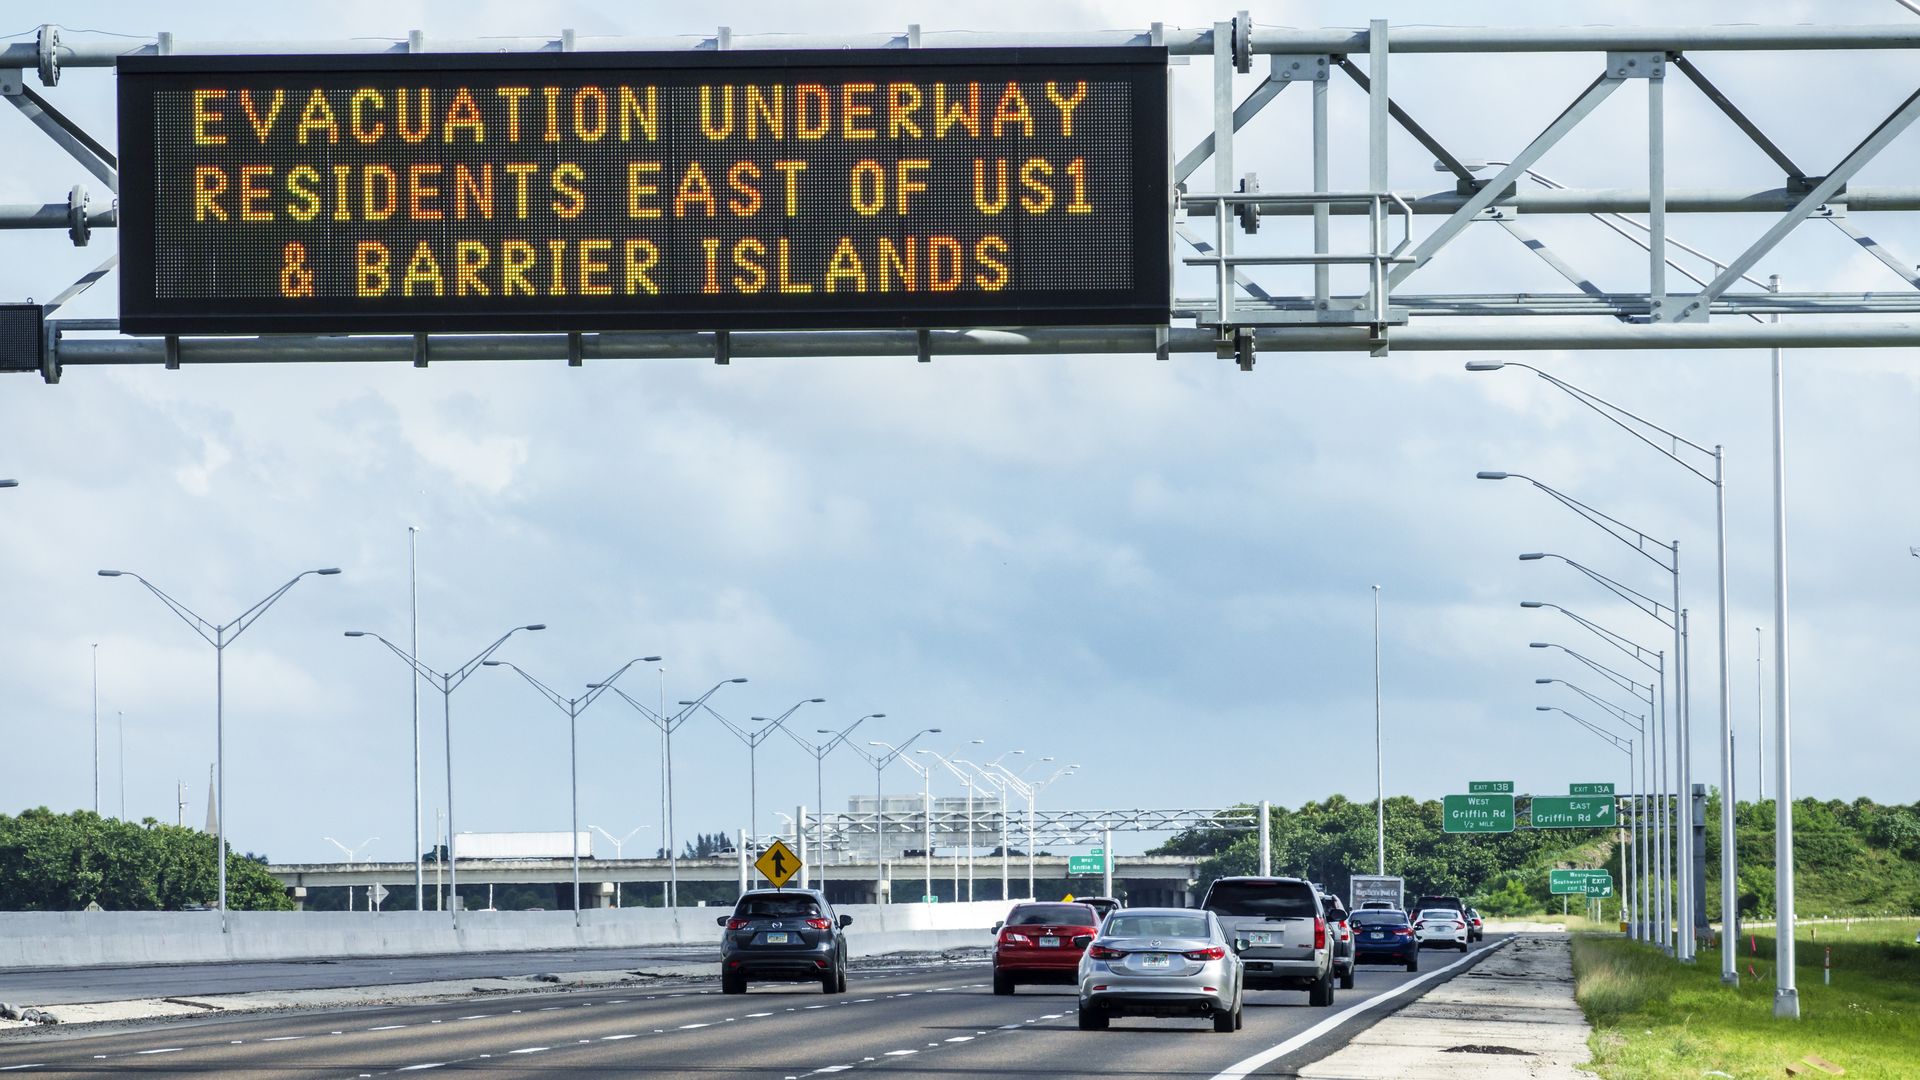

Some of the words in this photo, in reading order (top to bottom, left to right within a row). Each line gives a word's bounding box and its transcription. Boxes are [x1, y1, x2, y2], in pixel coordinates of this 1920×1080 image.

[195, 86, 657, 144] EVACUATION
[701, 81, 1086, 140] UNDERWAY
[195, 163, 584, 221] RESIDENTS
[629, 161, 807, 218] EAST
[852, 160, 930, 215] OF
[974, 158, 1092, 214] US1
[281, 243, 313, 297] &
[358, 239, 658, 296] BARRIER
[703, 236, 1008, 294] ISLANDS
[1493, 781, 1509, 791] 13B
[1594, 785, 1610, 793] 13A
[1468, 797, 1490, 806] WEST
[1569, 802, 1591, 811] EAST
[1452, 810, 1488, 819] Griffin
[1493, 810, 1506, 819] Rd
[1537, 814, 1573, 824] Griffin
[1578, 814, 1591, 823] Rd
